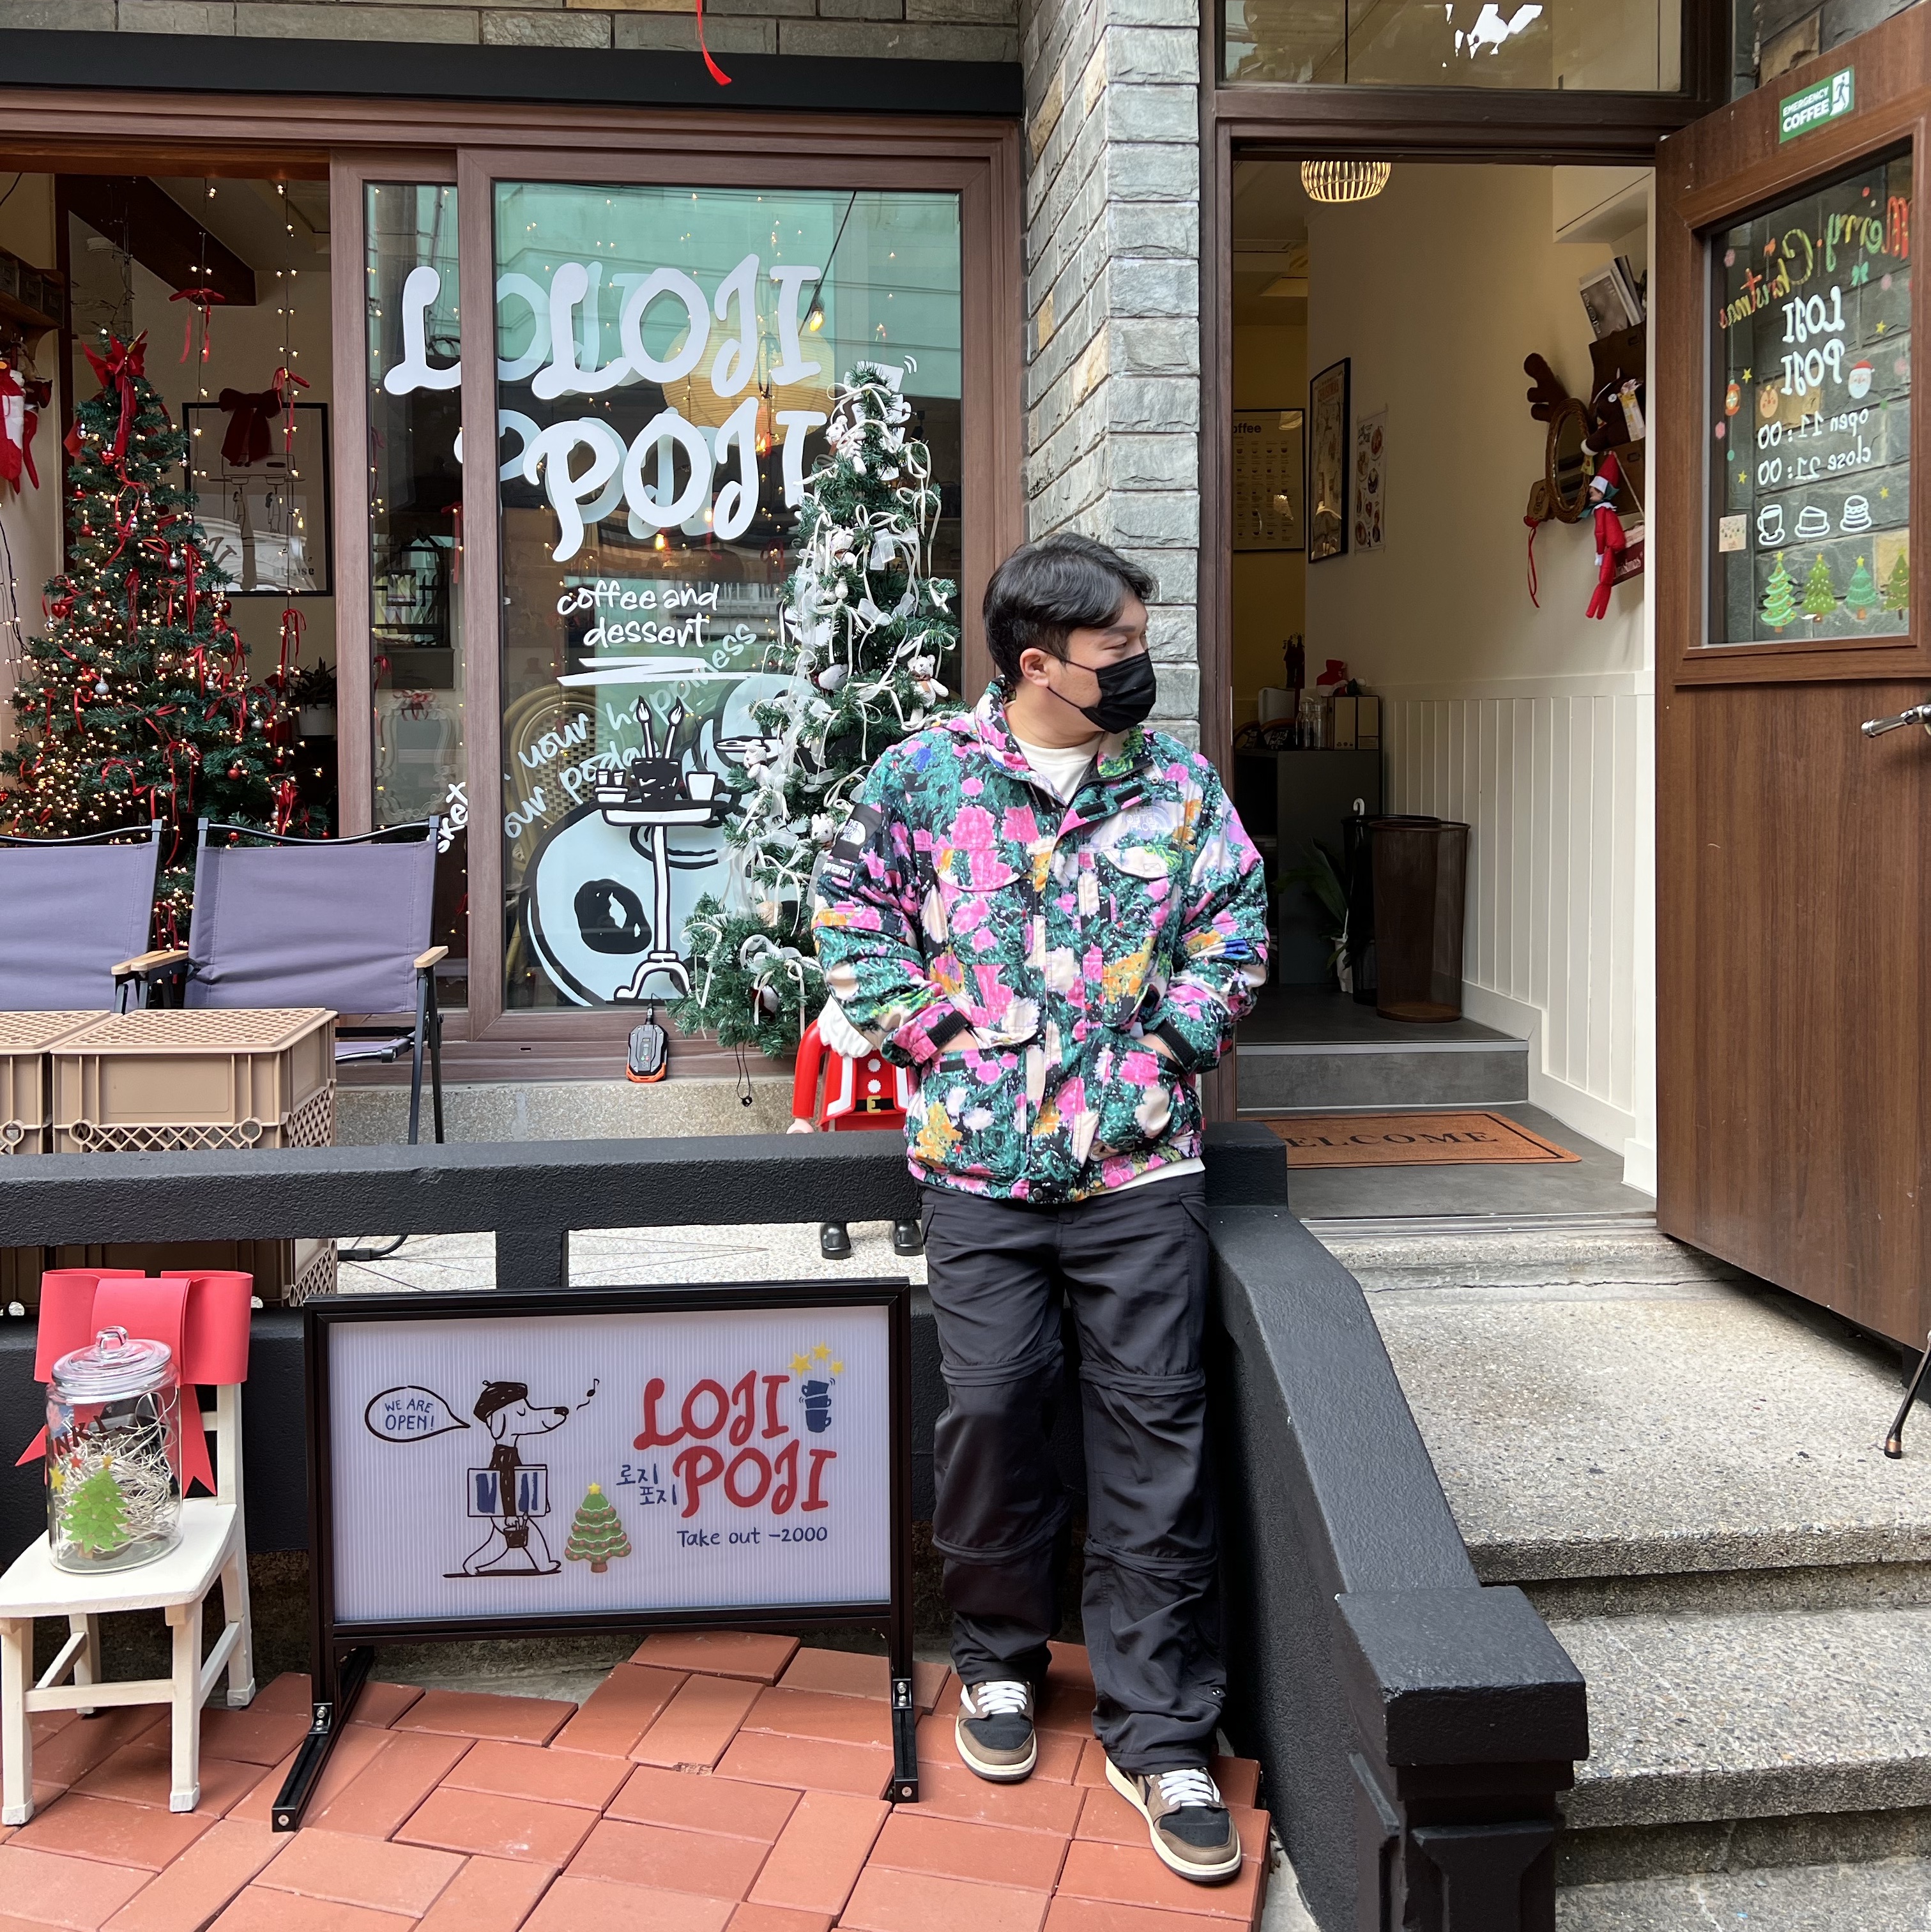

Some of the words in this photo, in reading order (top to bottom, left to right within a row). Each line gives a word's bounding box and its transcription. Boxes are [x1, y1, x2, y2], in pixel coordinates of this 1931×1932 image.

[1782, 86, 1829, 118] EMERGENCY
[1782, 98, 1829, 133] COFFEE
[531, 254, 822, 400] LOJI
[1233, 422, 1262, 434] offee
[523, 397, 827, 562] POJI
[556, 579, 658, 615] coffee
[662, 582, 721, 612] and
[583, 612, 710, 648] dessert
[1285, 1131, 1499, 1149] ELCOME
[385, 1399, 402, 1412] WE
[406, 1398, 434, 1413] ARE
[633, 1369, 790, 1450] LOJI
[385, 1414, 434, 1431] OPEN!
[616, 1463, 659, 1486] 로지
[672, 1438, 837, 1519] POJI
[639, 1484, 677, 1506] 포지
[676, 1528, 721, 1548] Take
[728, 1526, 761, 1544] out
